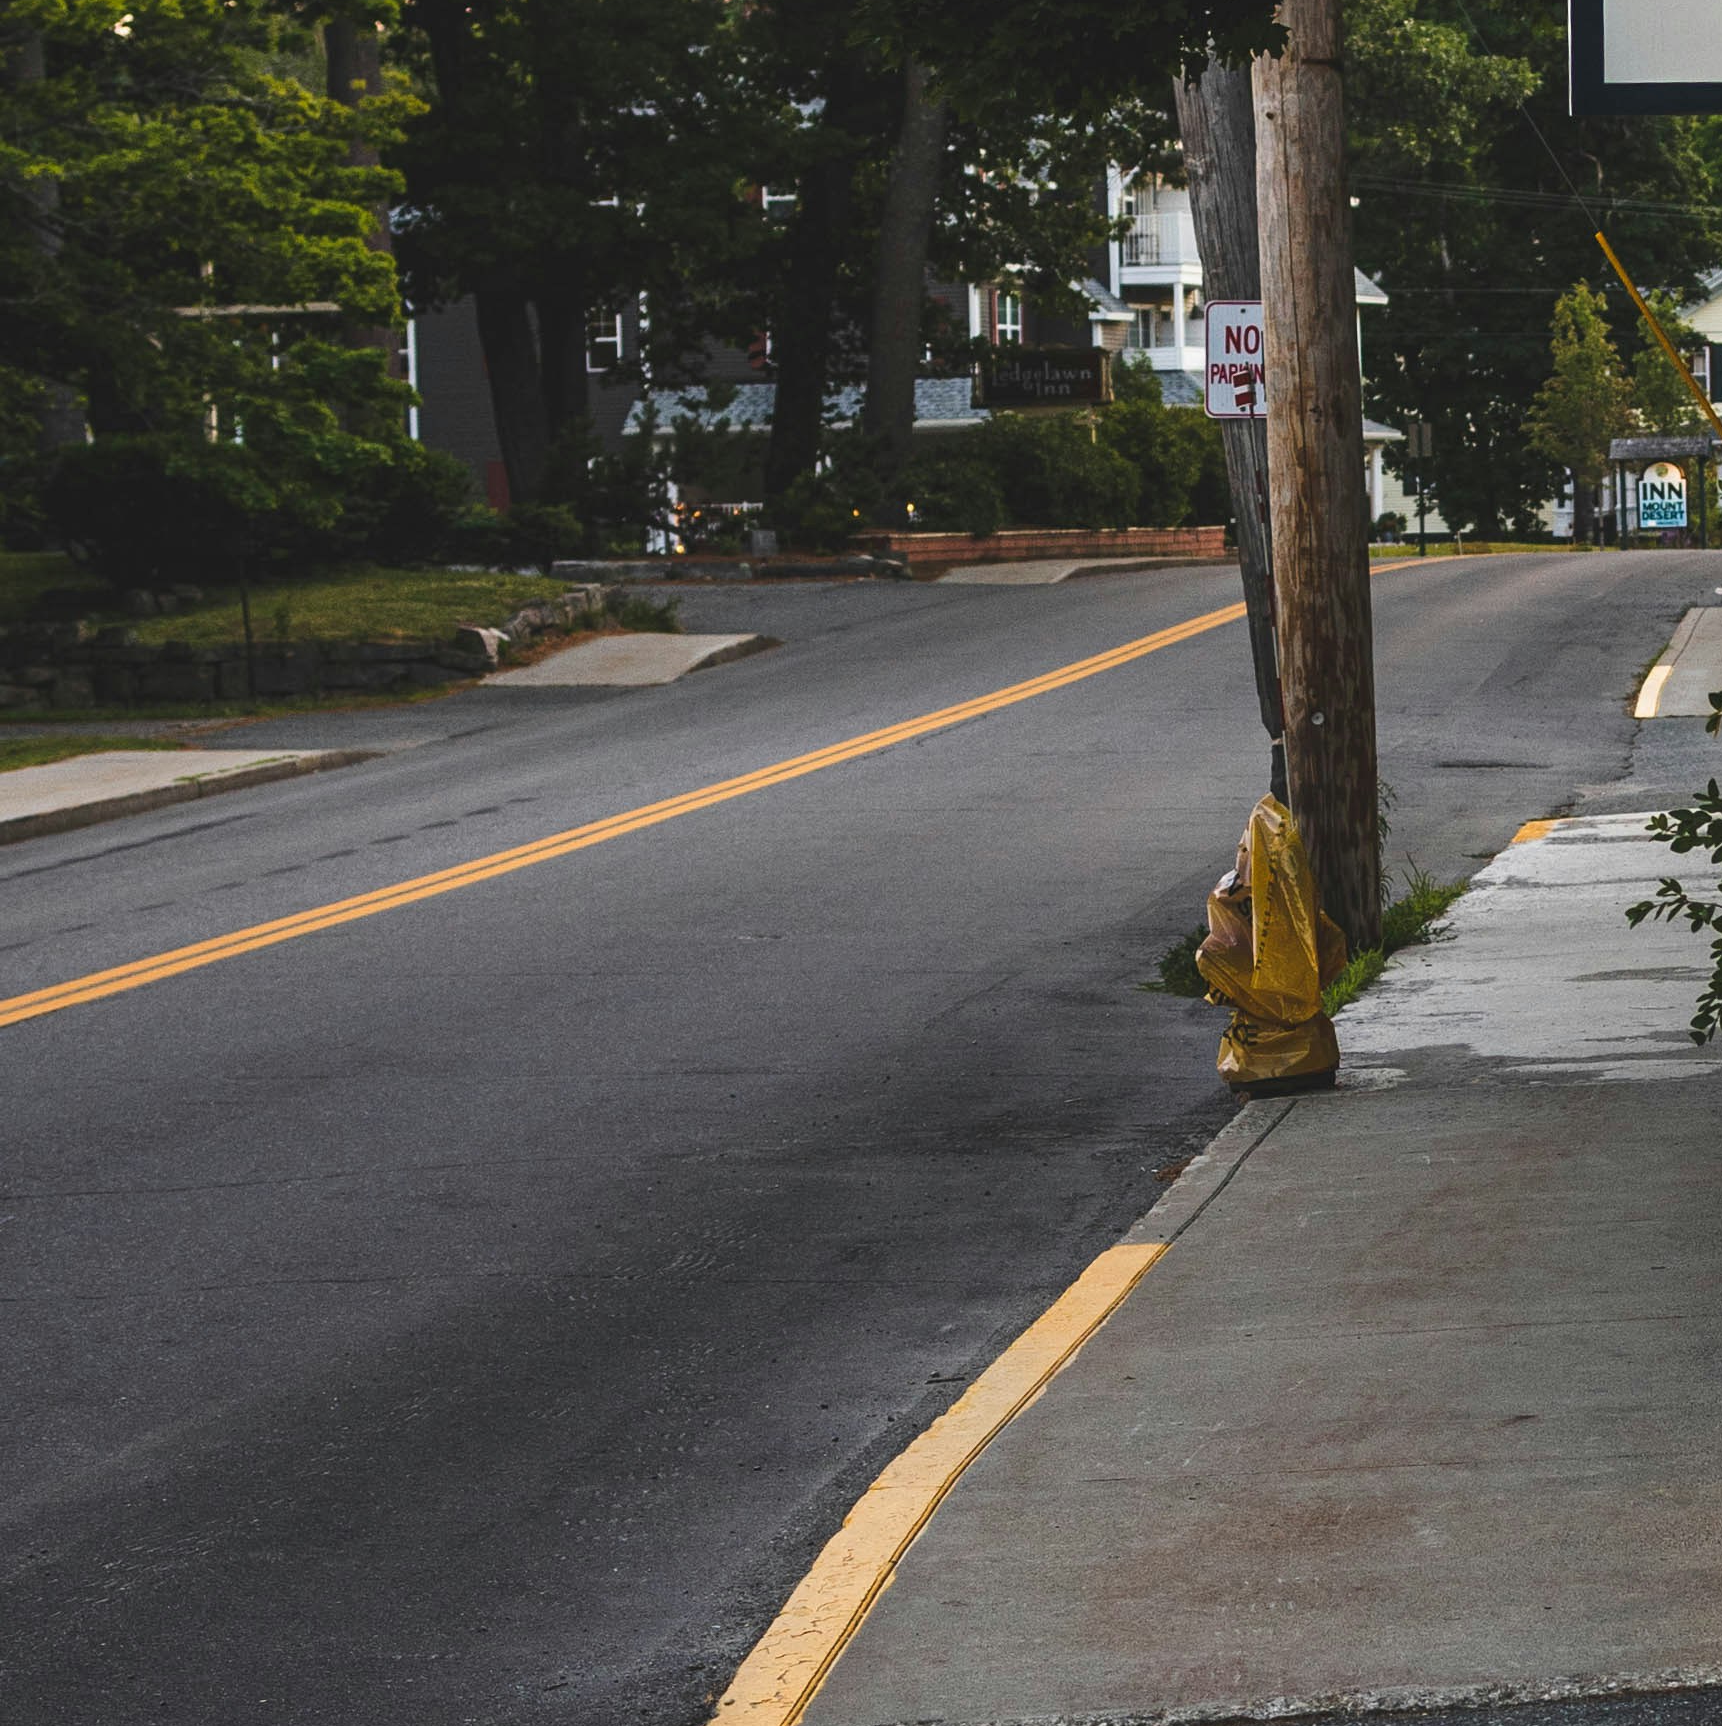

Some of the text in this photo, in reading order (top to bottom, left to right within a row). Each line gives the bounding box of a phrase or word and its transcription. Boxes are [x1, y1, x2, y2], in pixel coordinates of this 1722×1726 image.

[1225, 325, 1260, 354] NO
[1210, 363, 1264, 384] PARN
[1642, 482, 1683, 500] INN
[1642, 501, 1684, 511] MOUNT
[1642, 510, 1685, 520] DESERT
